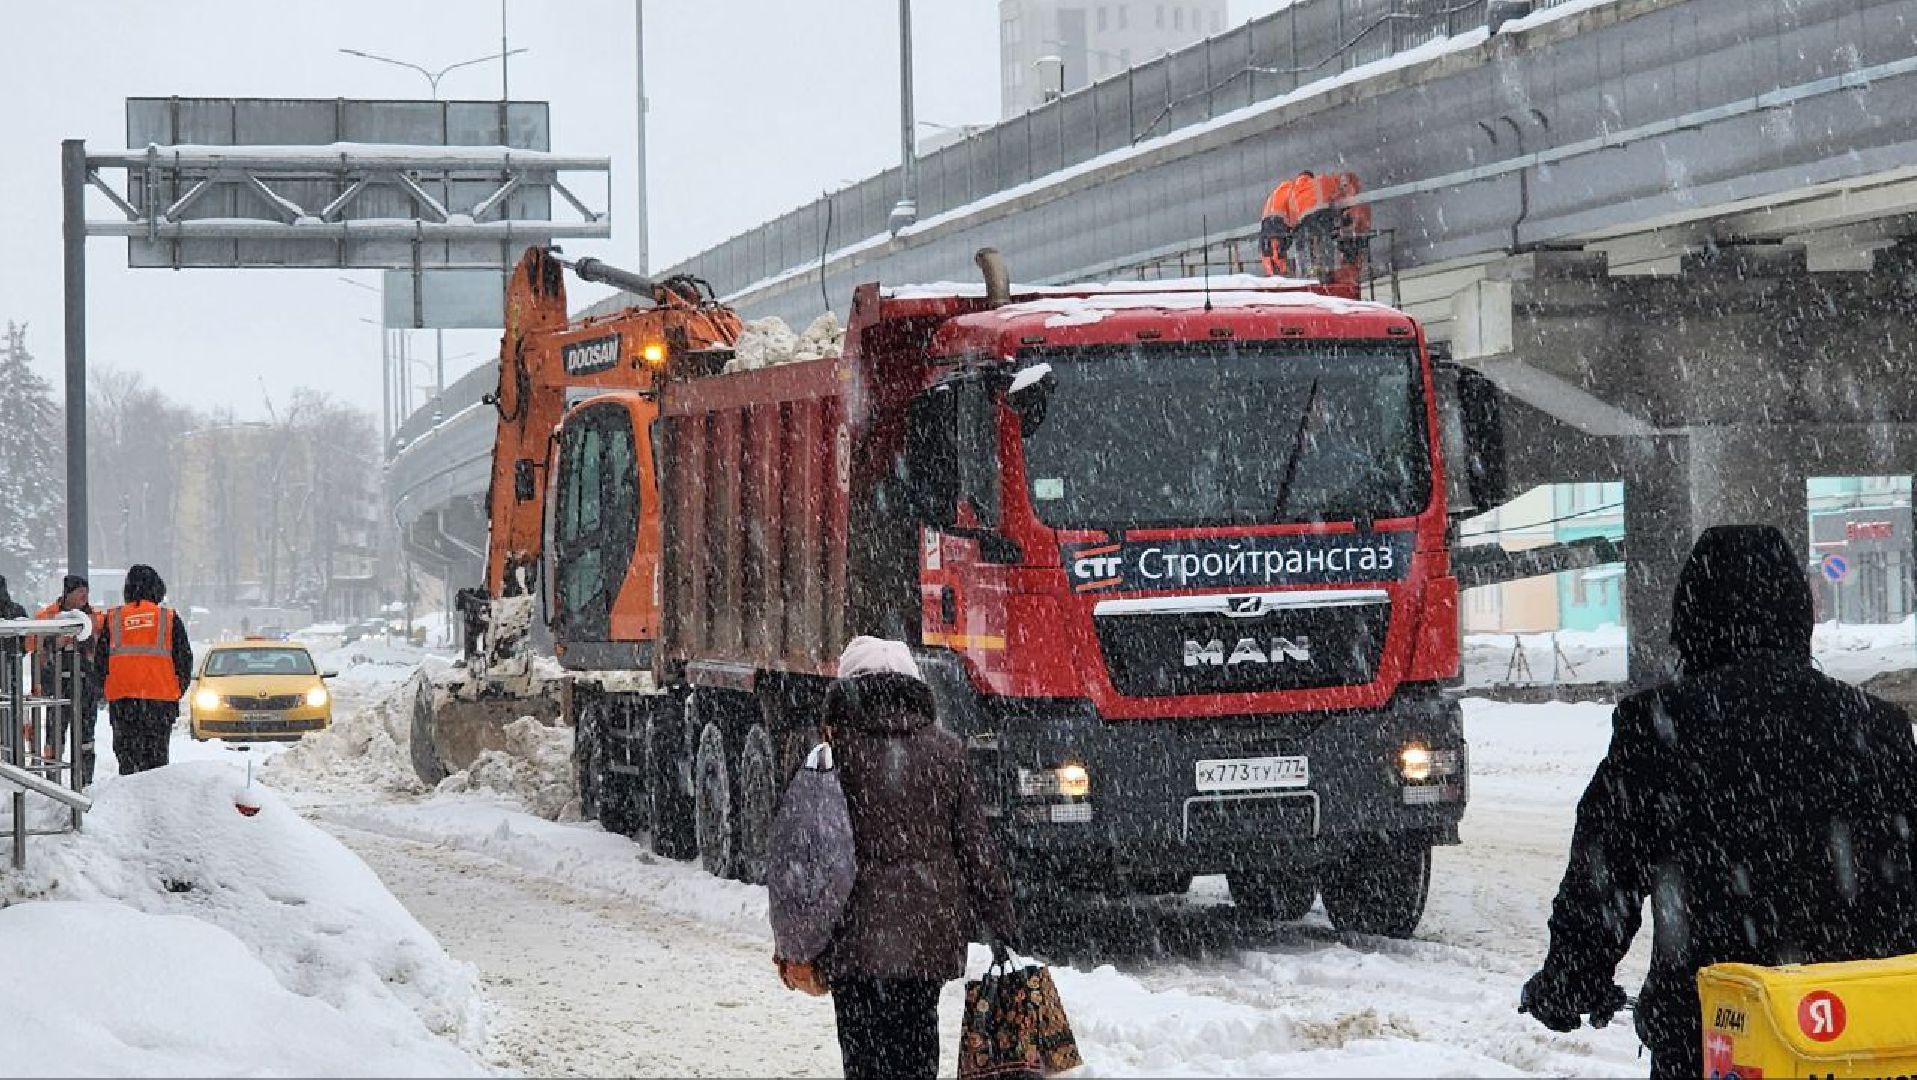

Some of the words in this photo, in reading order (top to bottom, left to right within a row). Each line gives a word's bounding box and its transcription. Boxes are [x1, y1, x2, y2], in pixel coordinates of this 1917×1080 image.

[568, 339, 619, 370] DOOSAN
[1138, 544, 1393, 586] Стройтрансгаз
[1183, 636, 1311, 666] MAN
[1809, 999, 1834, 1034] Я
